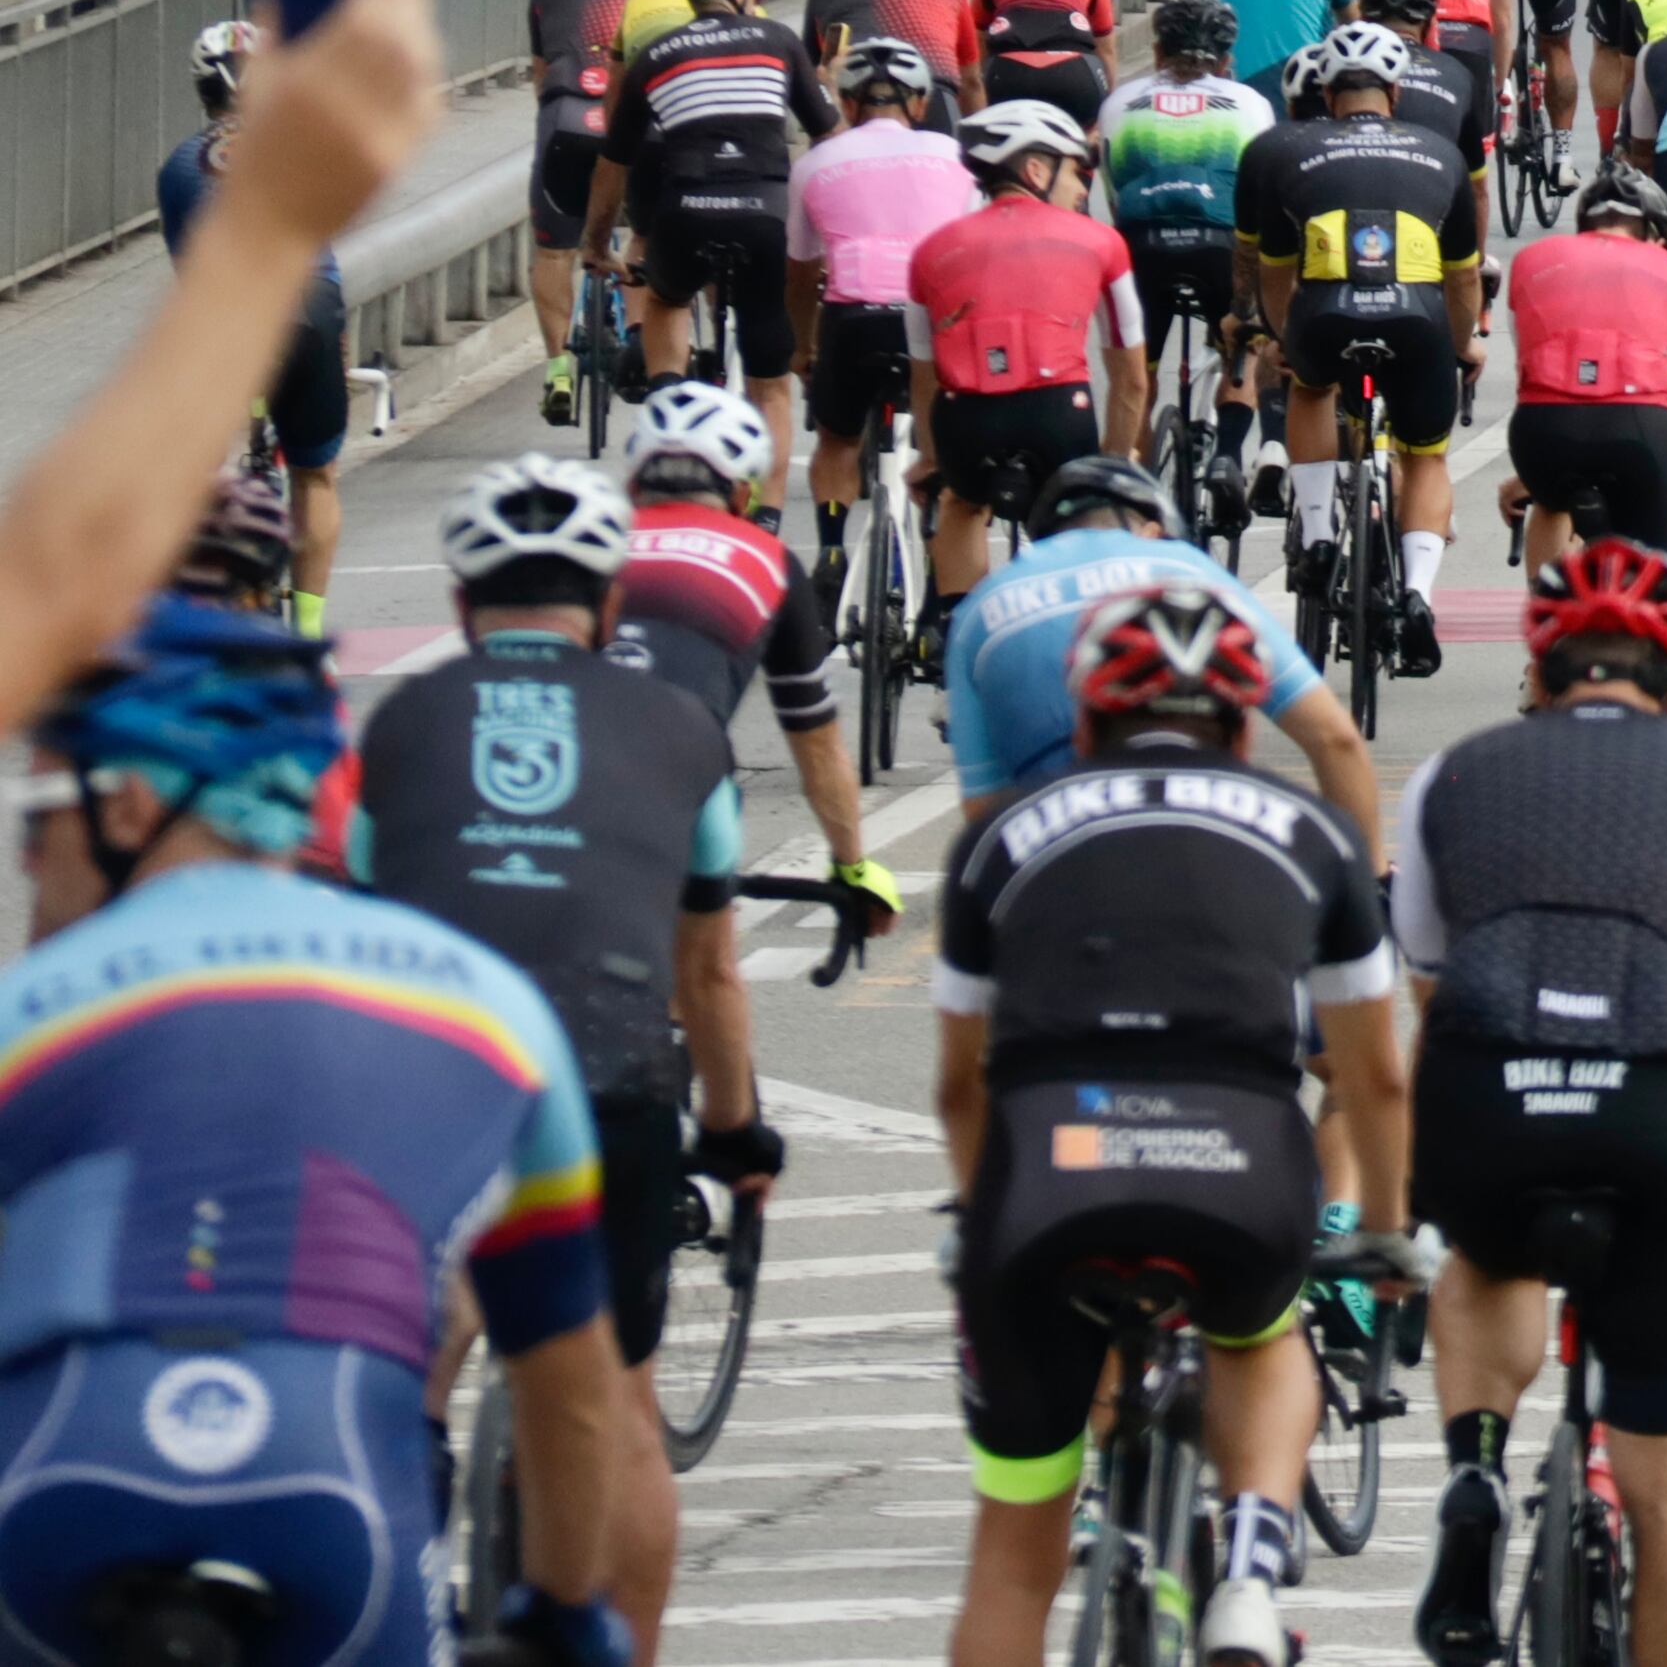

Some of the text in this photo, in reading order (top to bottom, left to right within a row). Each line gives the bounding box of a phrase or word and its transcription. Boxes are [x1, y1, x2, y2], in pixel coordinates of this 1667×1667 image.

[648, 26, 766, 61] PROTOURBCN
[1299, 153, 1326, 171] BAR
[1357, 147, 1410, 162] CYCLING
[1411, 151, 1444, 171] CLUB
[680, 193, 766, 211] PROTOURBCN
[653, 534, 734, 566] BOX
[980, 561, 1154, 632] BIKE BOX
[1000, 773, 1303, 865] BIKE BOX
[1503, 1058, 1629, 1091] BIKE BOX
[1099, 1127, 1222, 1149] GOBIERNO
[1099, 1148, 1136, 1169] DE
